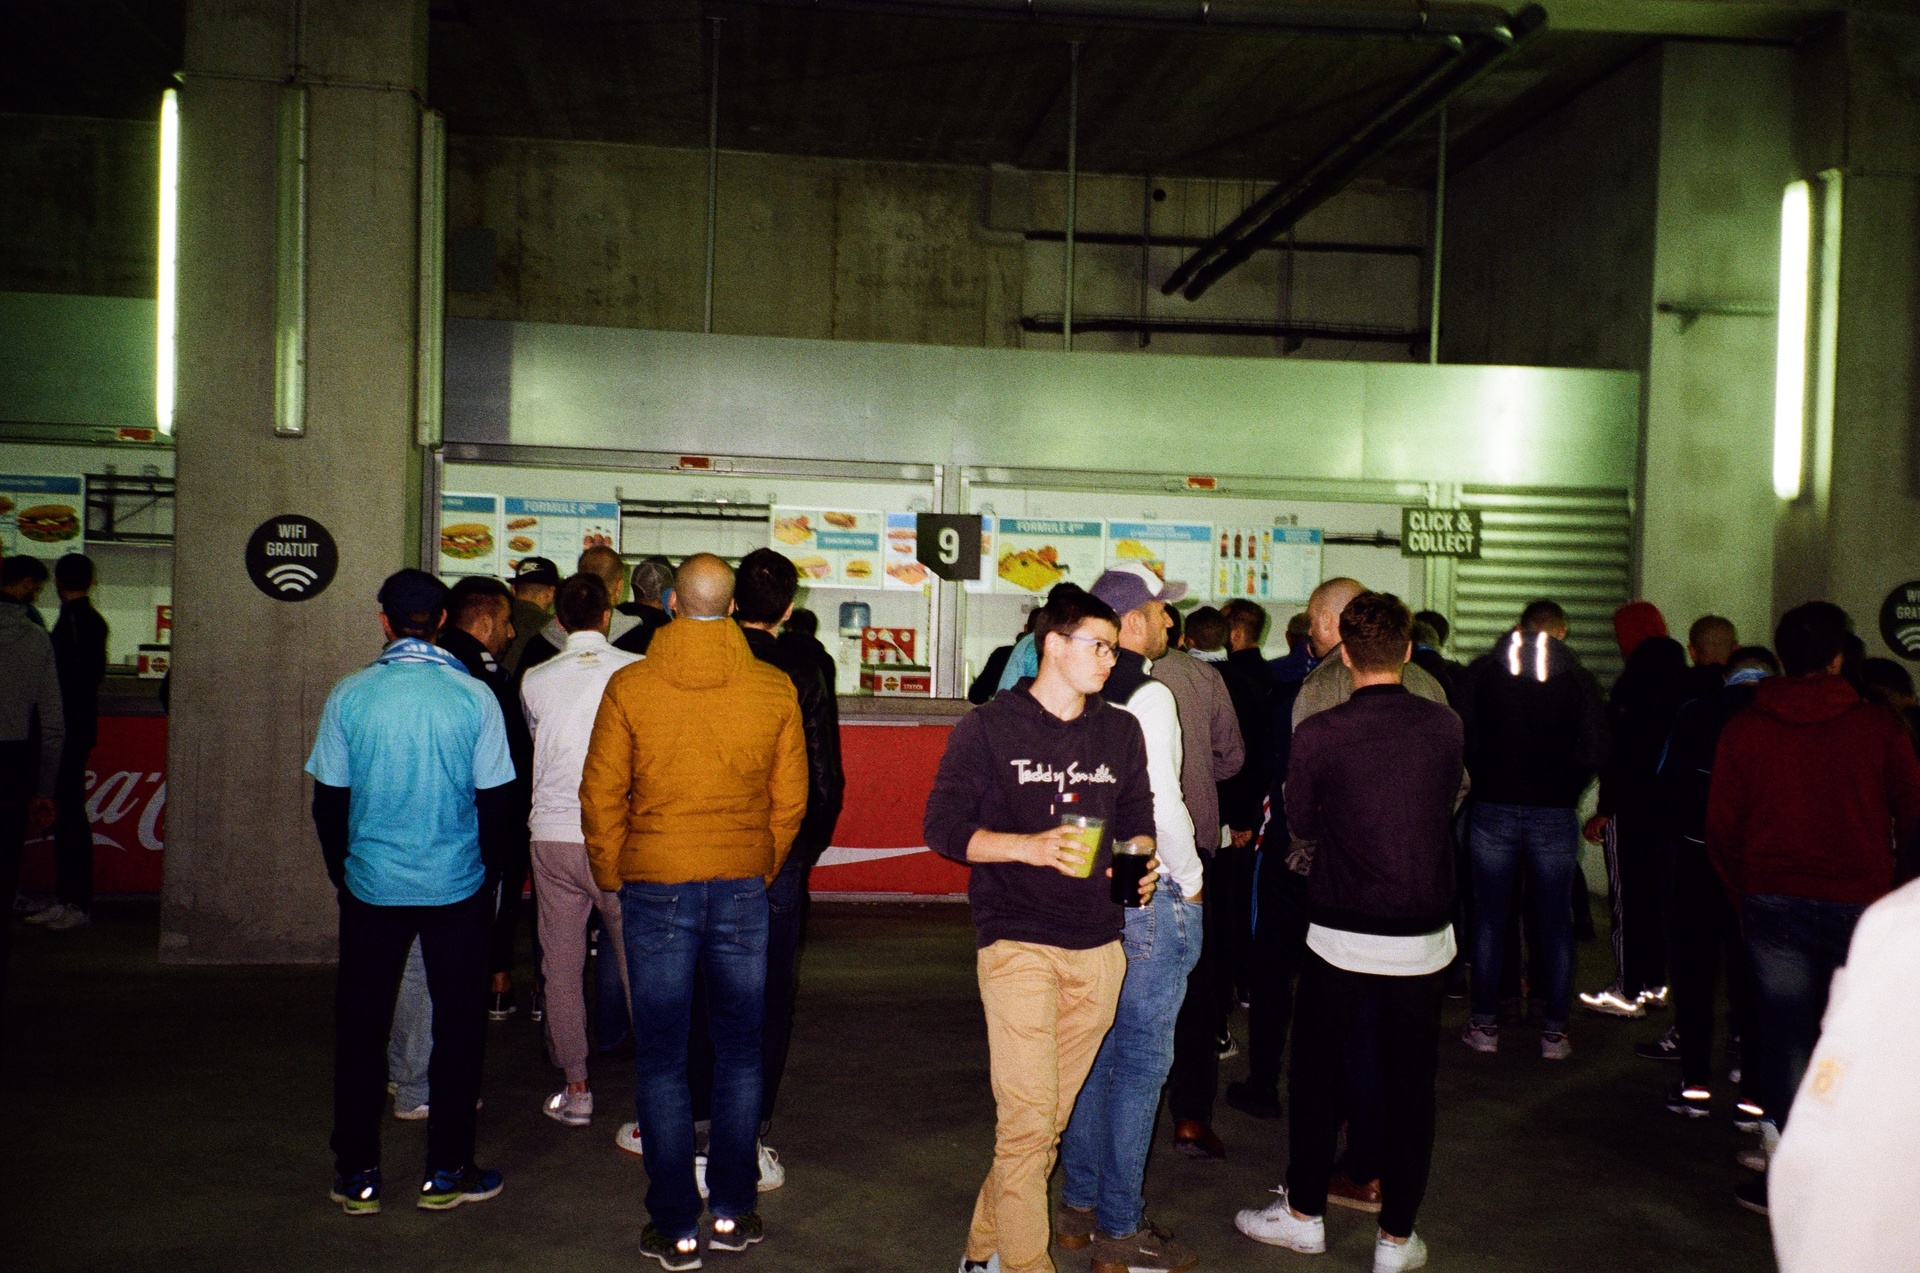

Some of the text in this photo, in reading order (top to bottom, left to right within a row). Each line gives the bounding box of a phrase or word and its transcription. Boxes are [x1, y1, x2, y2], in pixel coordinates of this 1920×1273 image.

[279, 524, 306, 539] WIFI
[1409, 510, 1473, 532] CLICK &
[266, 542, 319, 557] GRATUIT
[939, 527, 960, 565] 9
[1408, 531, 1474, 553] COLLECT
[1010, 759, 1117, 793] Teddy Smith
